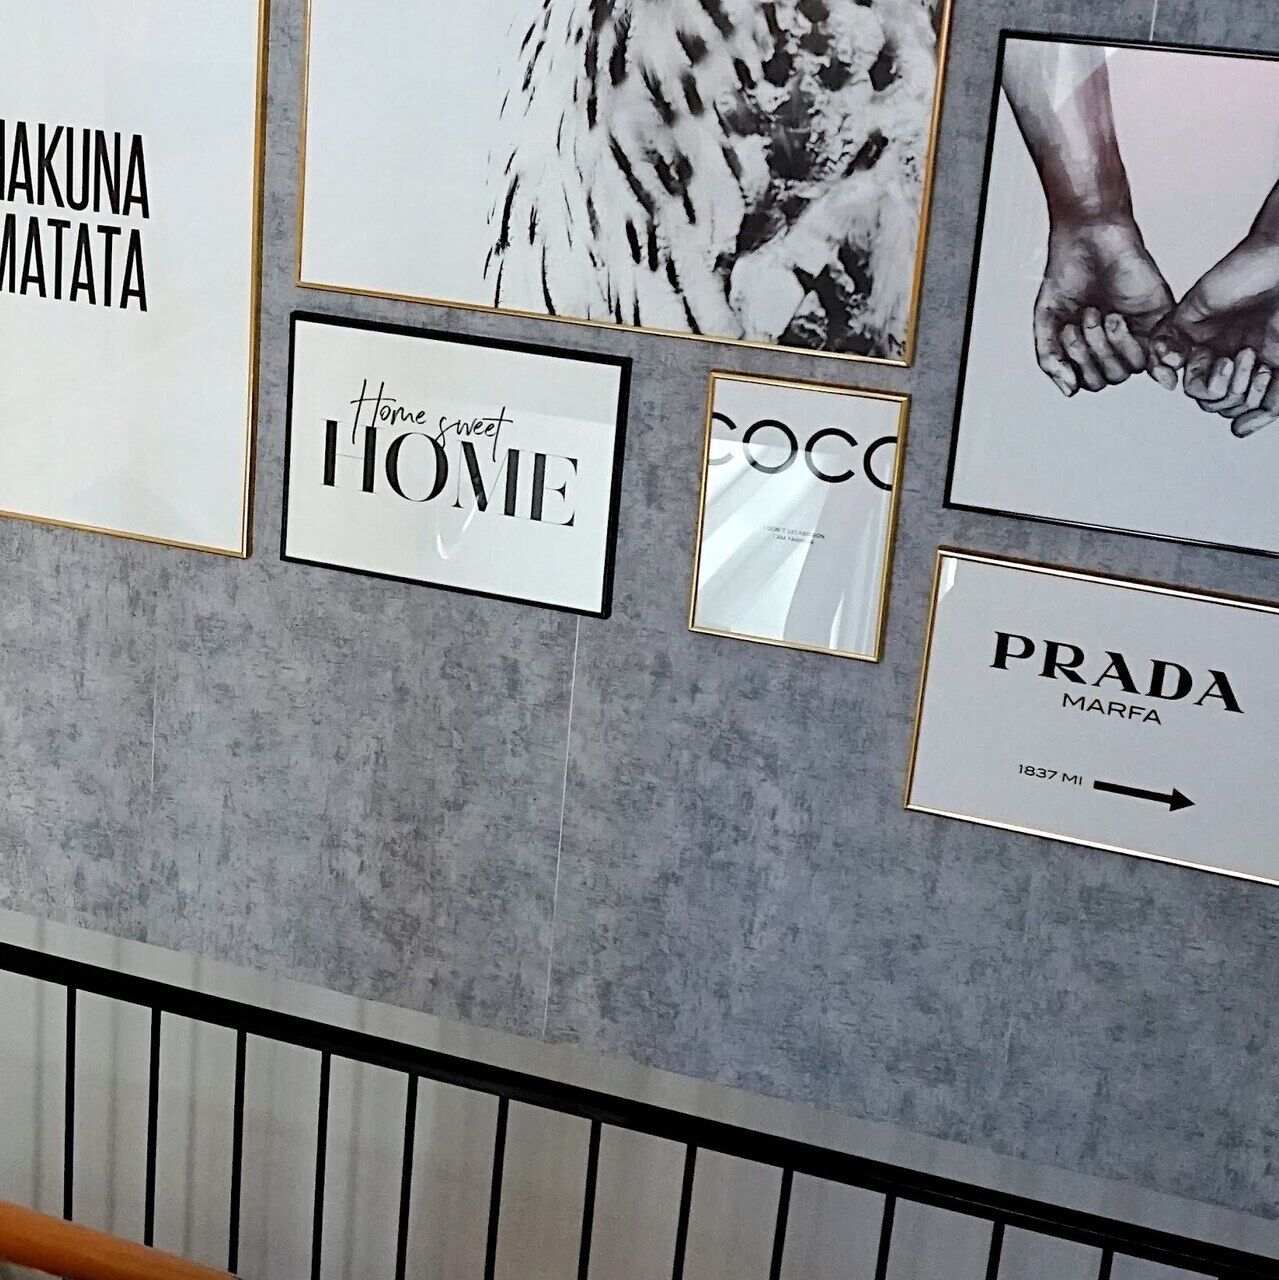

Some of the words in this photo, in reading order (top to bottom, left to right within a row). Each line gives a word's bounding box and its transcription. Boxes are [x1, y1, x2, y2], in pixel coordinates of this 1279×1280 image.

[350, 378, 427, 444] Home
[438, 407, 514, 462] sweet
[320, 418, 579, 528] HOME
[989, 630, 1245, 714] PRADA
[1062, 692, 1163, 726] MARFA
[1019, 764, 1058, 781] 1837
[1061, 772, 1083, 786] MI
